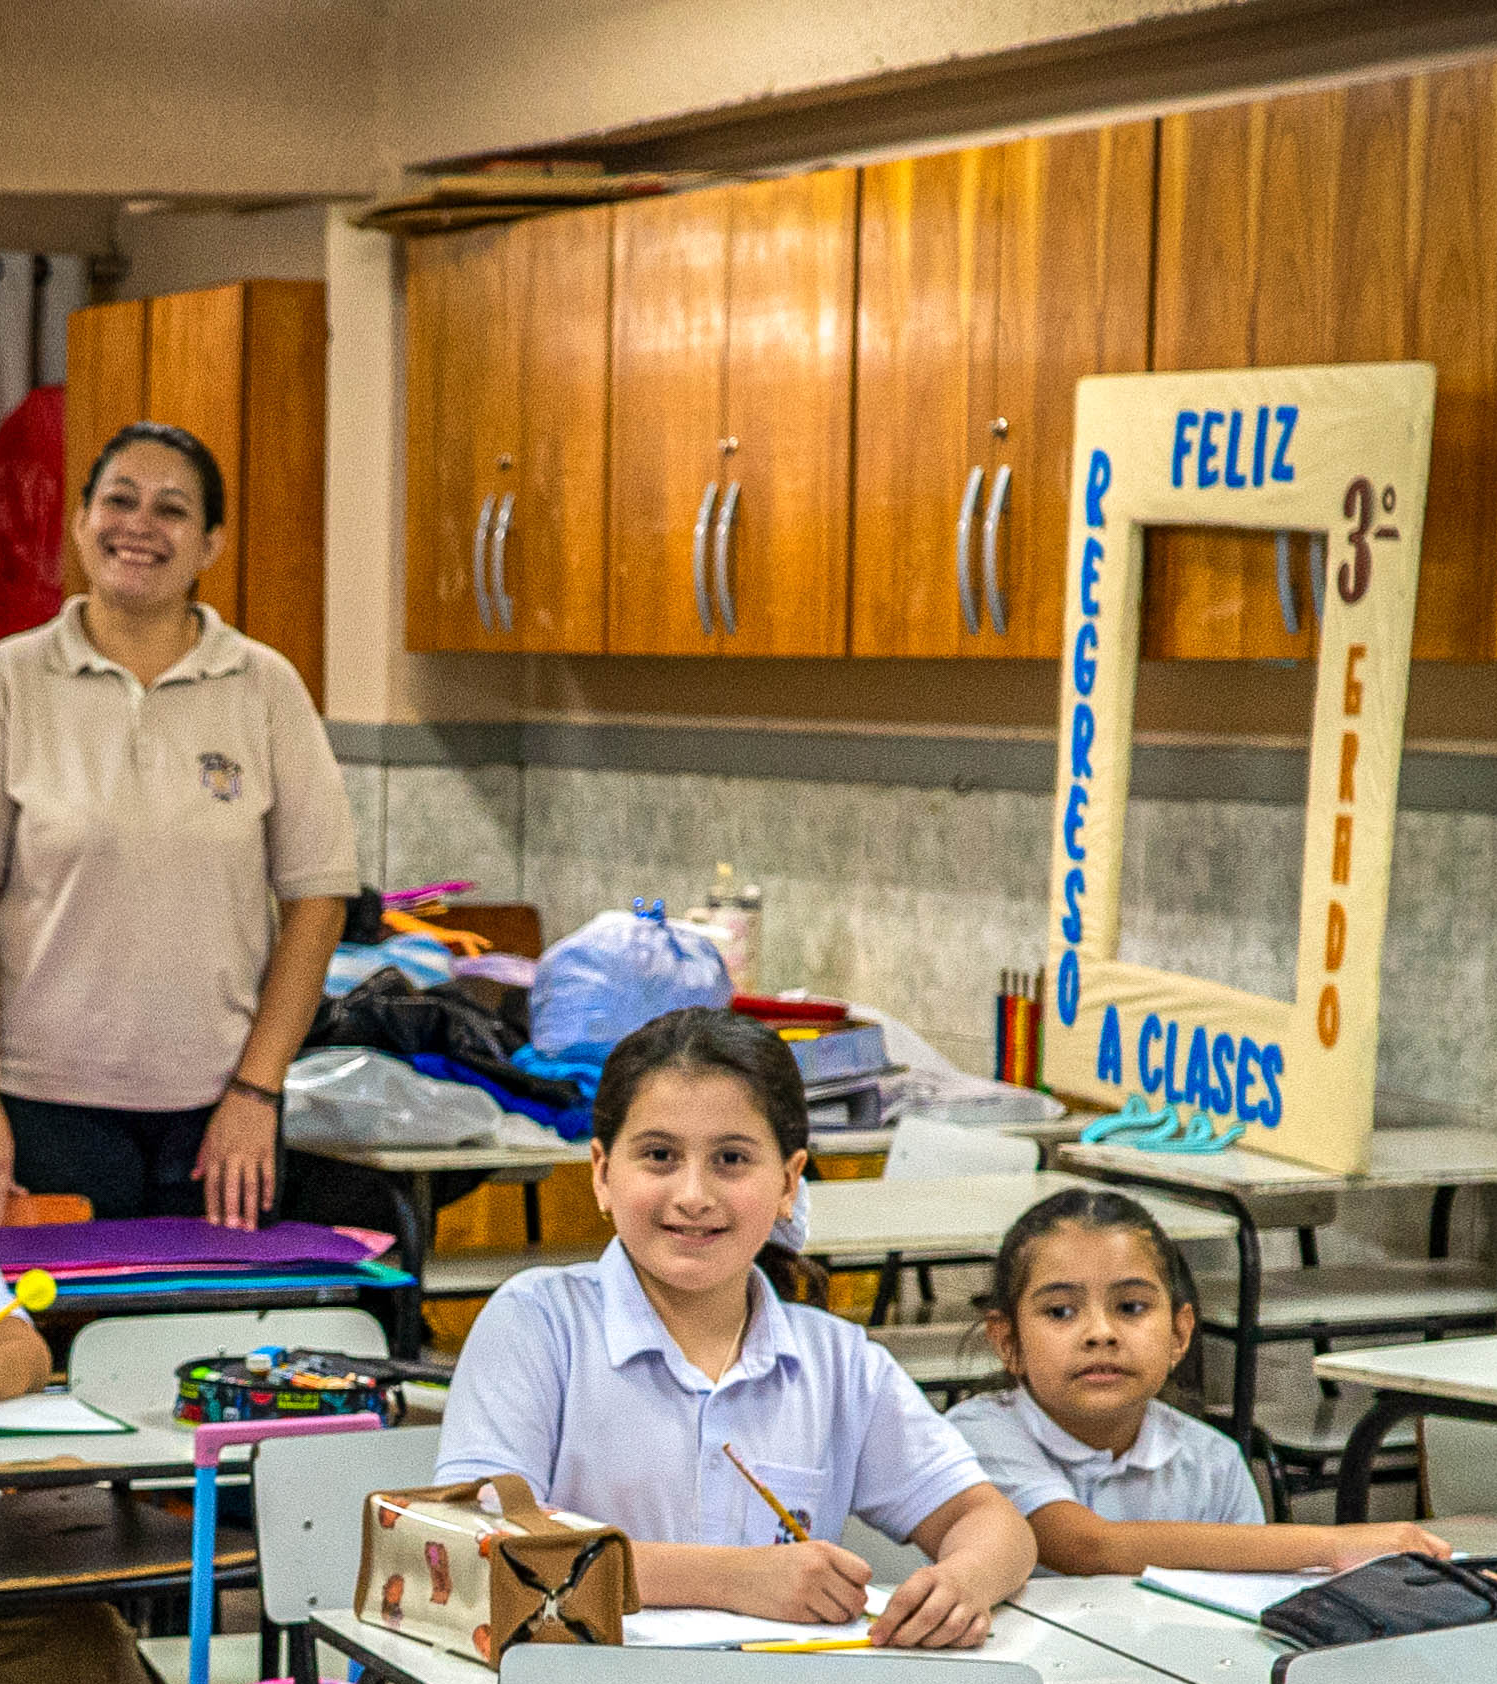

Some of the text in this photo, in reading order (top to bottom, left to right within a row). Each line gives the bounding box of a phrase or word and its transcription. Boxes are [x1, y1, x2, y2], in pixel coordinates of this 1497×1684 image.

[1172, 407, 1299, 490] FELIZ
[1058, 448, 1111, 1028] REGRESO
[1098, 1005, 1285, 1130] A CLASES
